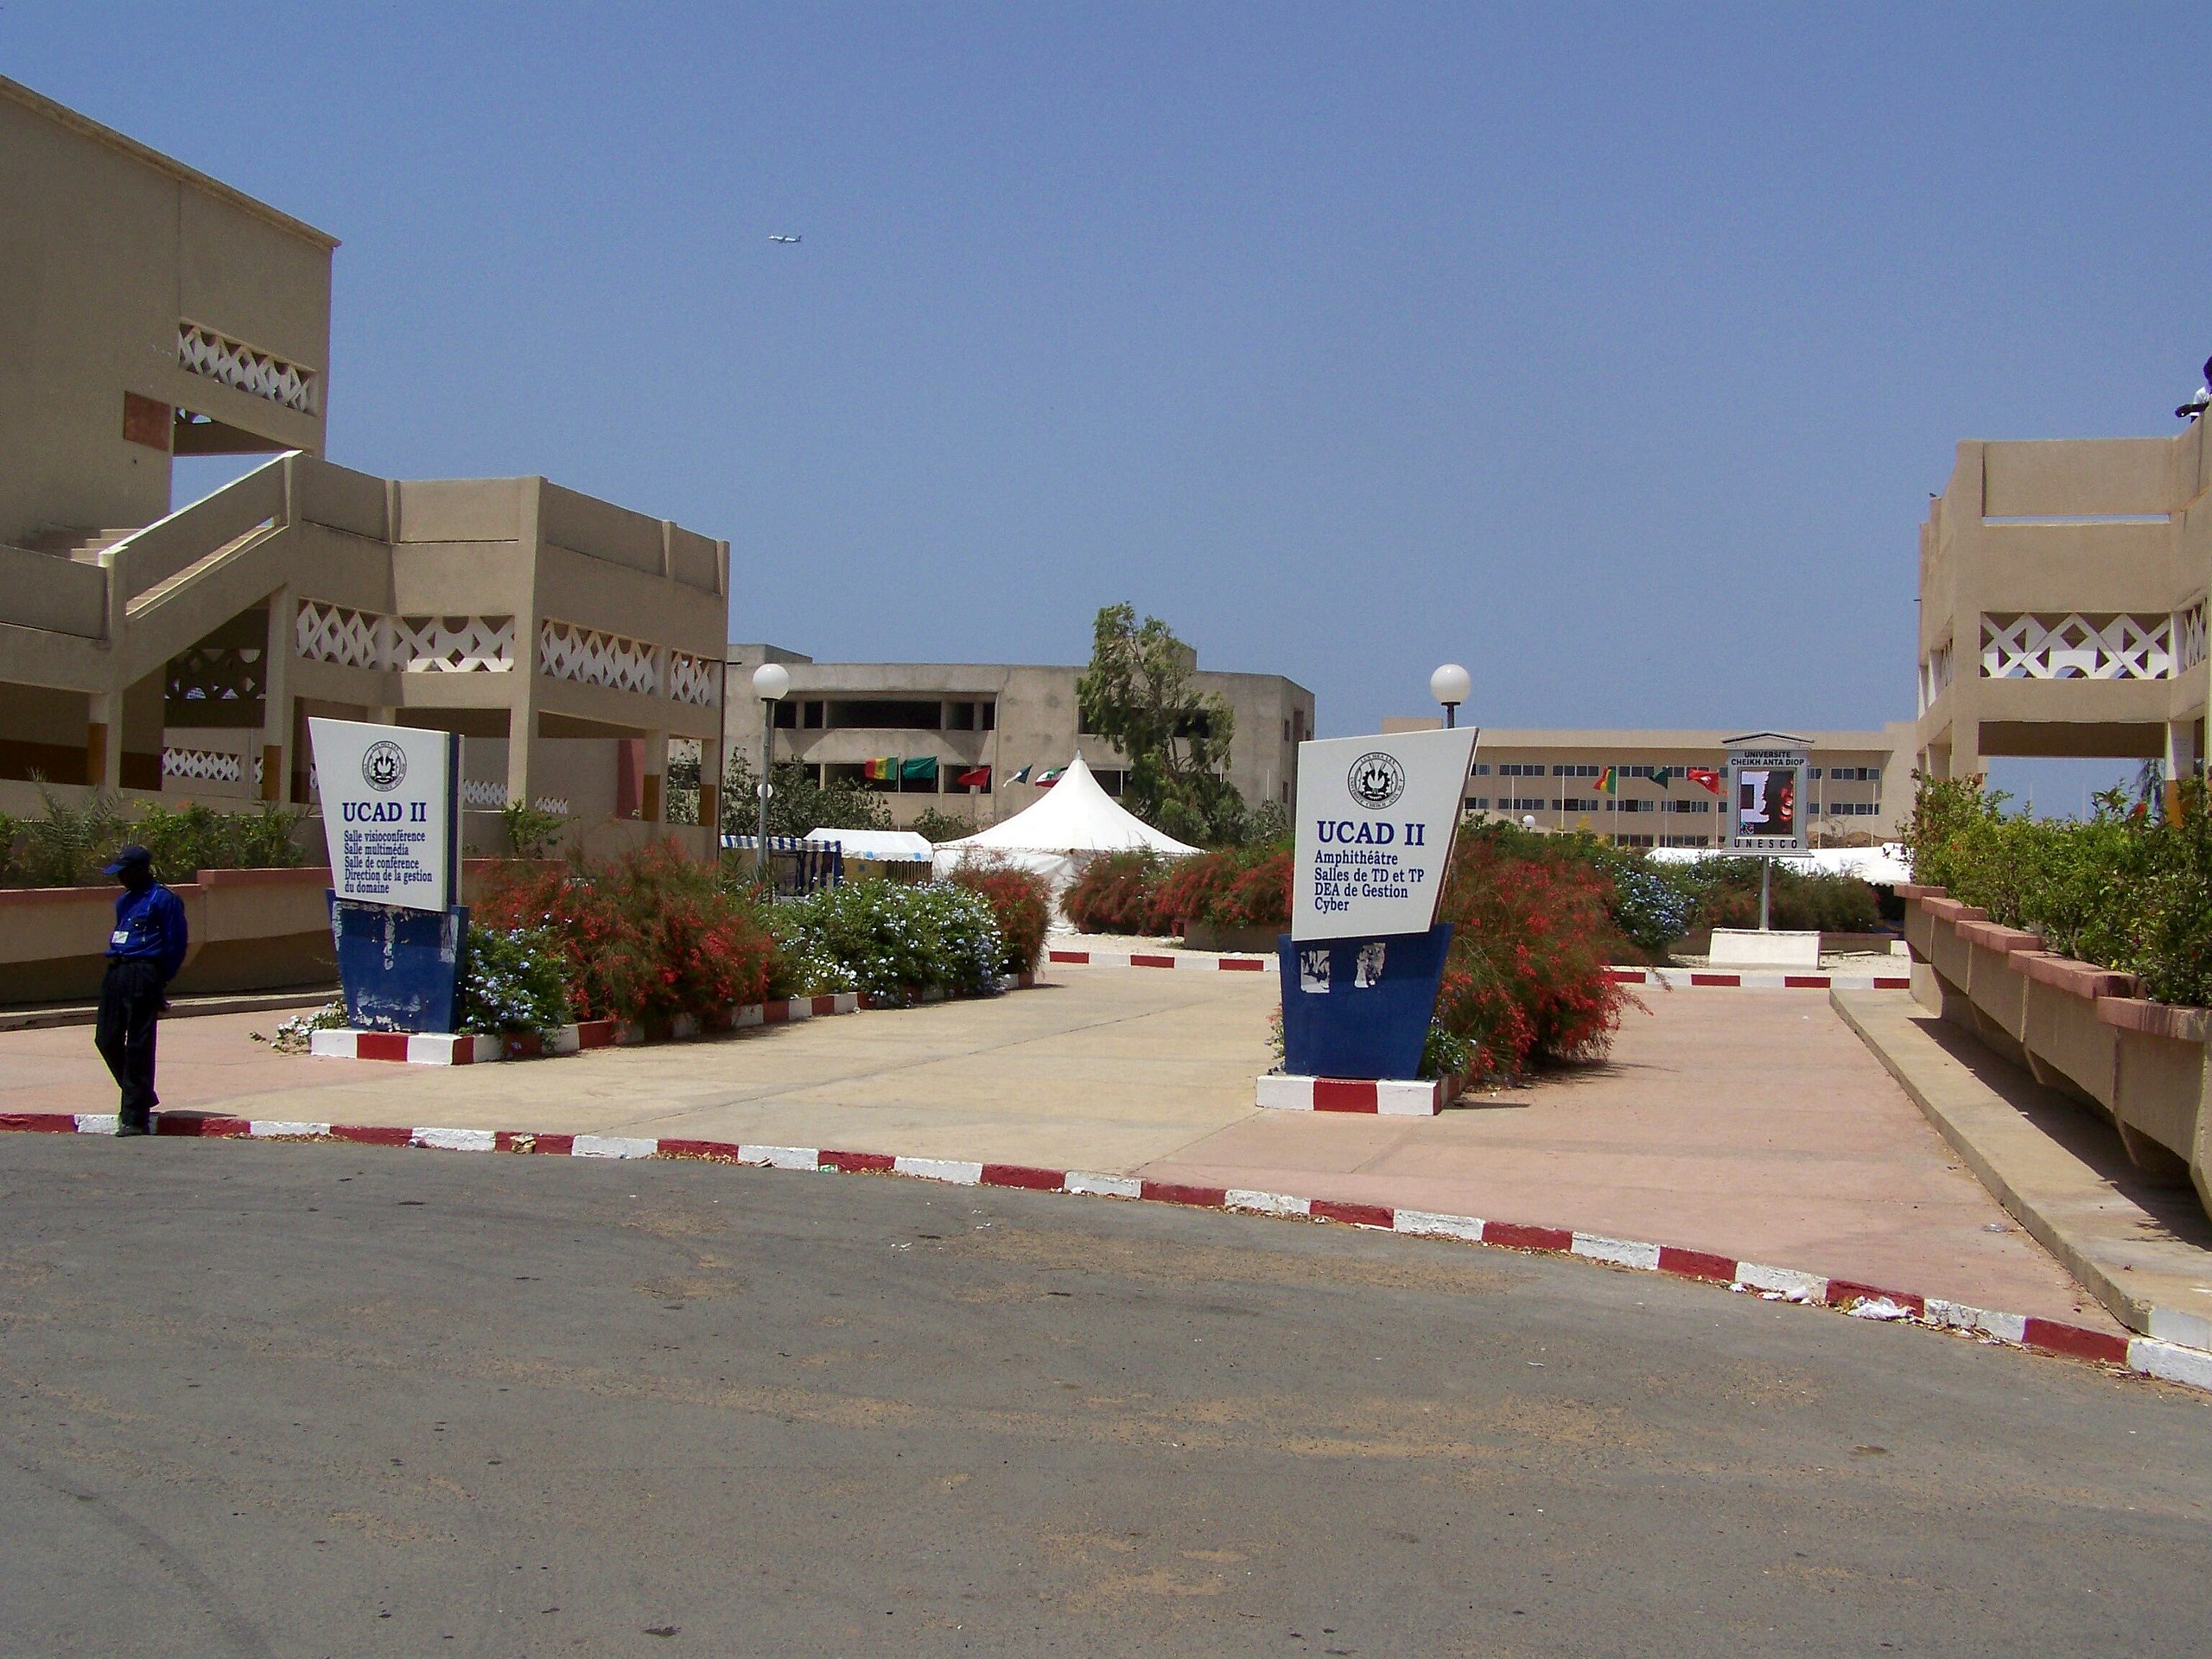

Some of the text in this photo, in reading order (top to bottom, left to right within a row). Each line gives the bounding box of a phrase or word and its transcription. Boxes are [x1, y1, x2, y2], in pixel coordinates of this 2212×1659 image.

[342, 802, 427, 822] UCAD II
[344, 830, 425, 842] Salle visioconférence
[1317, 821, 1425, 845] UCAD II
[345, 843, 409, 855] Salle multimédia
[1734, 839, 1797, 849] UNESCO
[345, 855, 419, 868] Salle de conférence
[1315, 849, 1398, 867] Amphithéâtre
[345, 868, 432, 885] Direction de la gestion
[1315, 868, 1424, 882] Salles de TD et TP
[345, 881, 389, 893] du domaine
[1315, 882, 1408, 898] DEA de Gestion
[1315, 897, 1349, 914] Cyber
